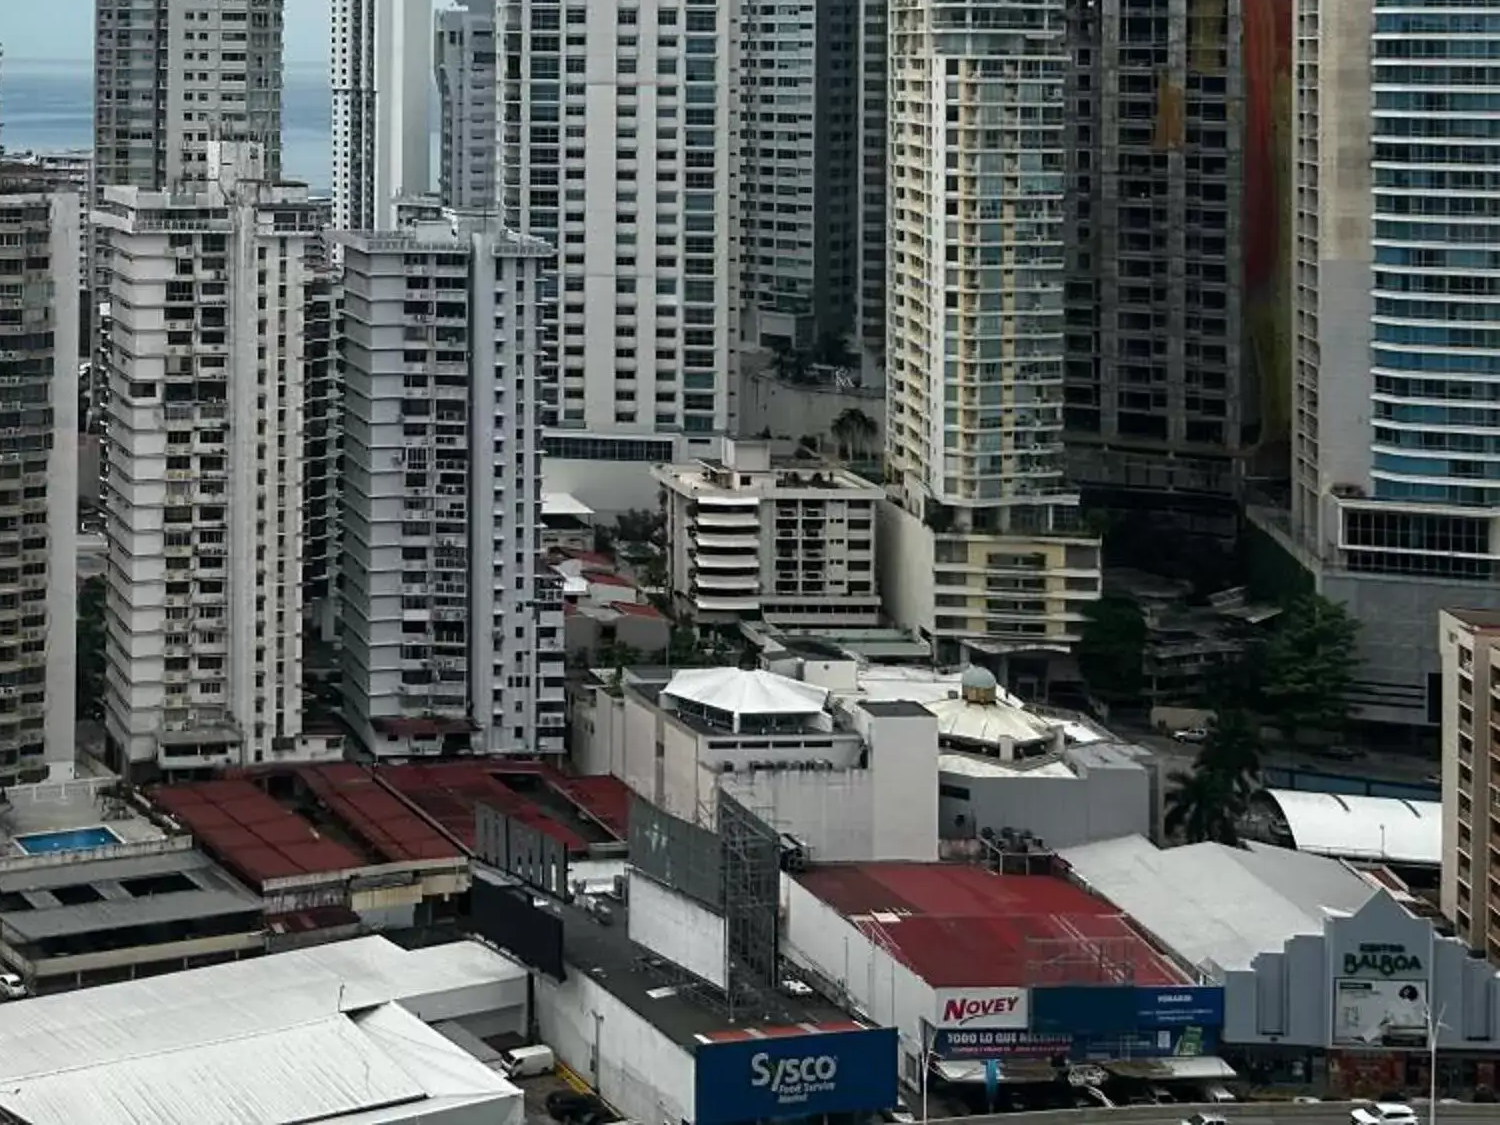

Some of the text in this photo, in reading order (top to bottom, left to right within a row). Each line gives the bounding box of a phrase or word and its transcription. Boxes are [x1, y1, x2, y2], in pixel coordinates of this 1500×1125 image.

[1343, 953, 1423, 976] BALBOA
[943, 996, 1020, 1022] NOVEY
[979, 1032, 993, 1044] LO
